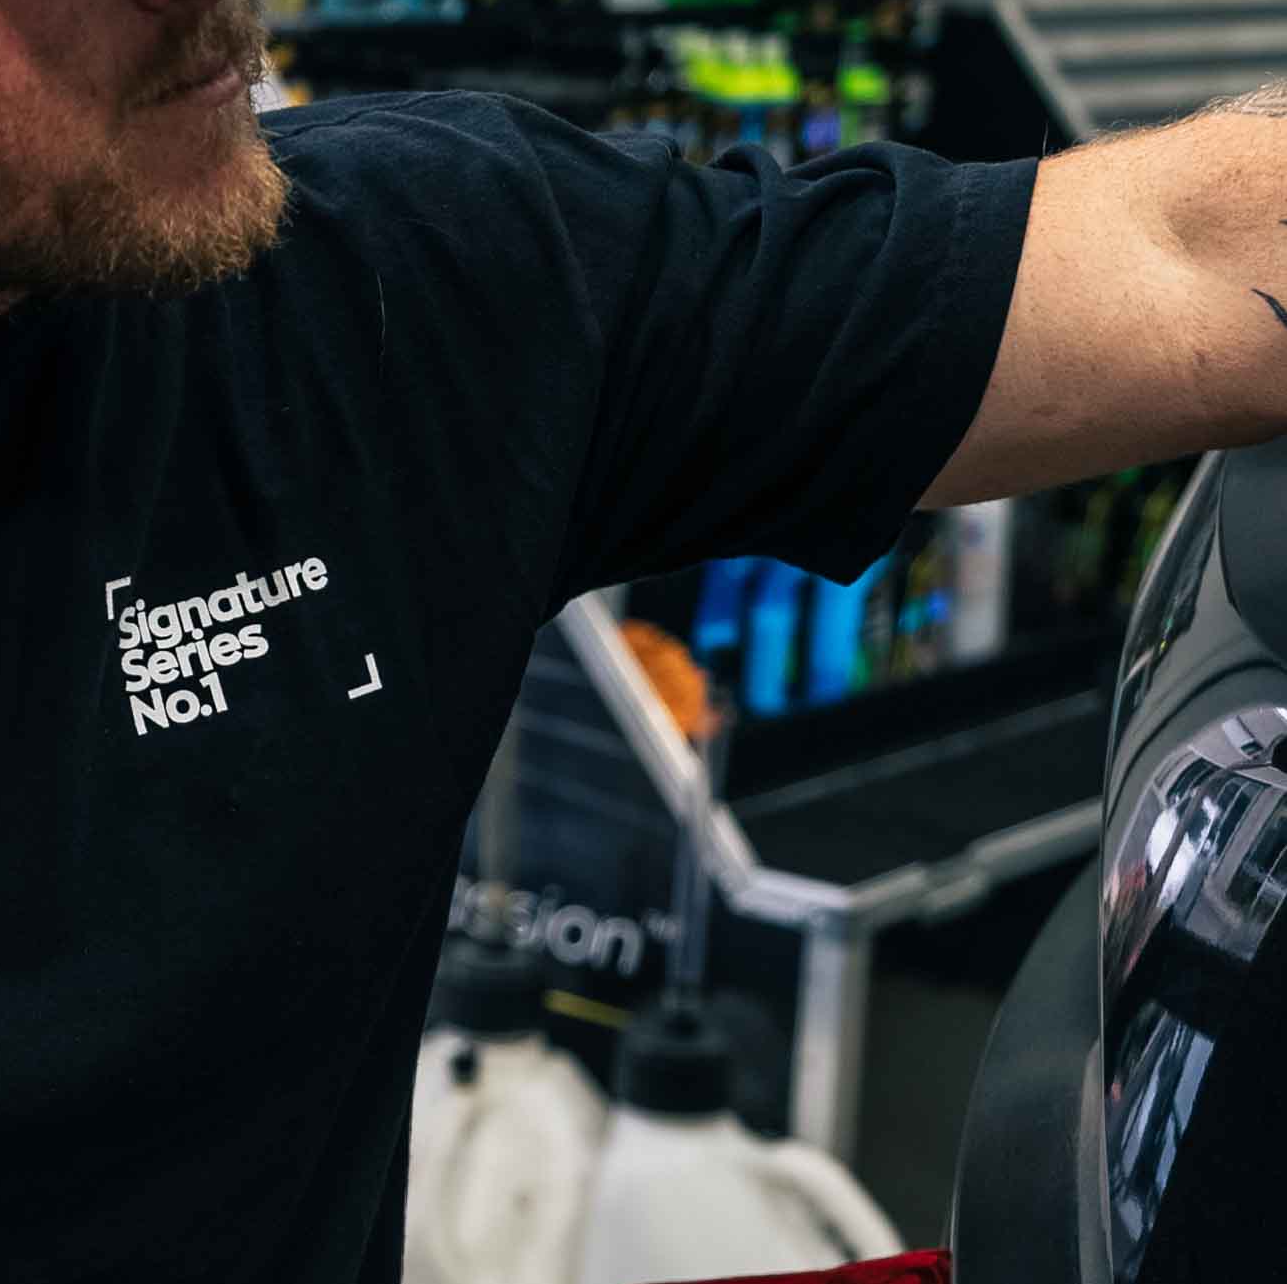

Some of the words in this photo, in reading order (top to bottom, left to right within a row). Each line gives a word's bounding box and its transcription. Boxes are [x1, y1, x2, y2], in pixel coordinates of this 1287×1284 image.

[118, 557, 329, 649] Signature
[121, 624, 270, 692] Series
[129, 671, 229, 736] No.1
